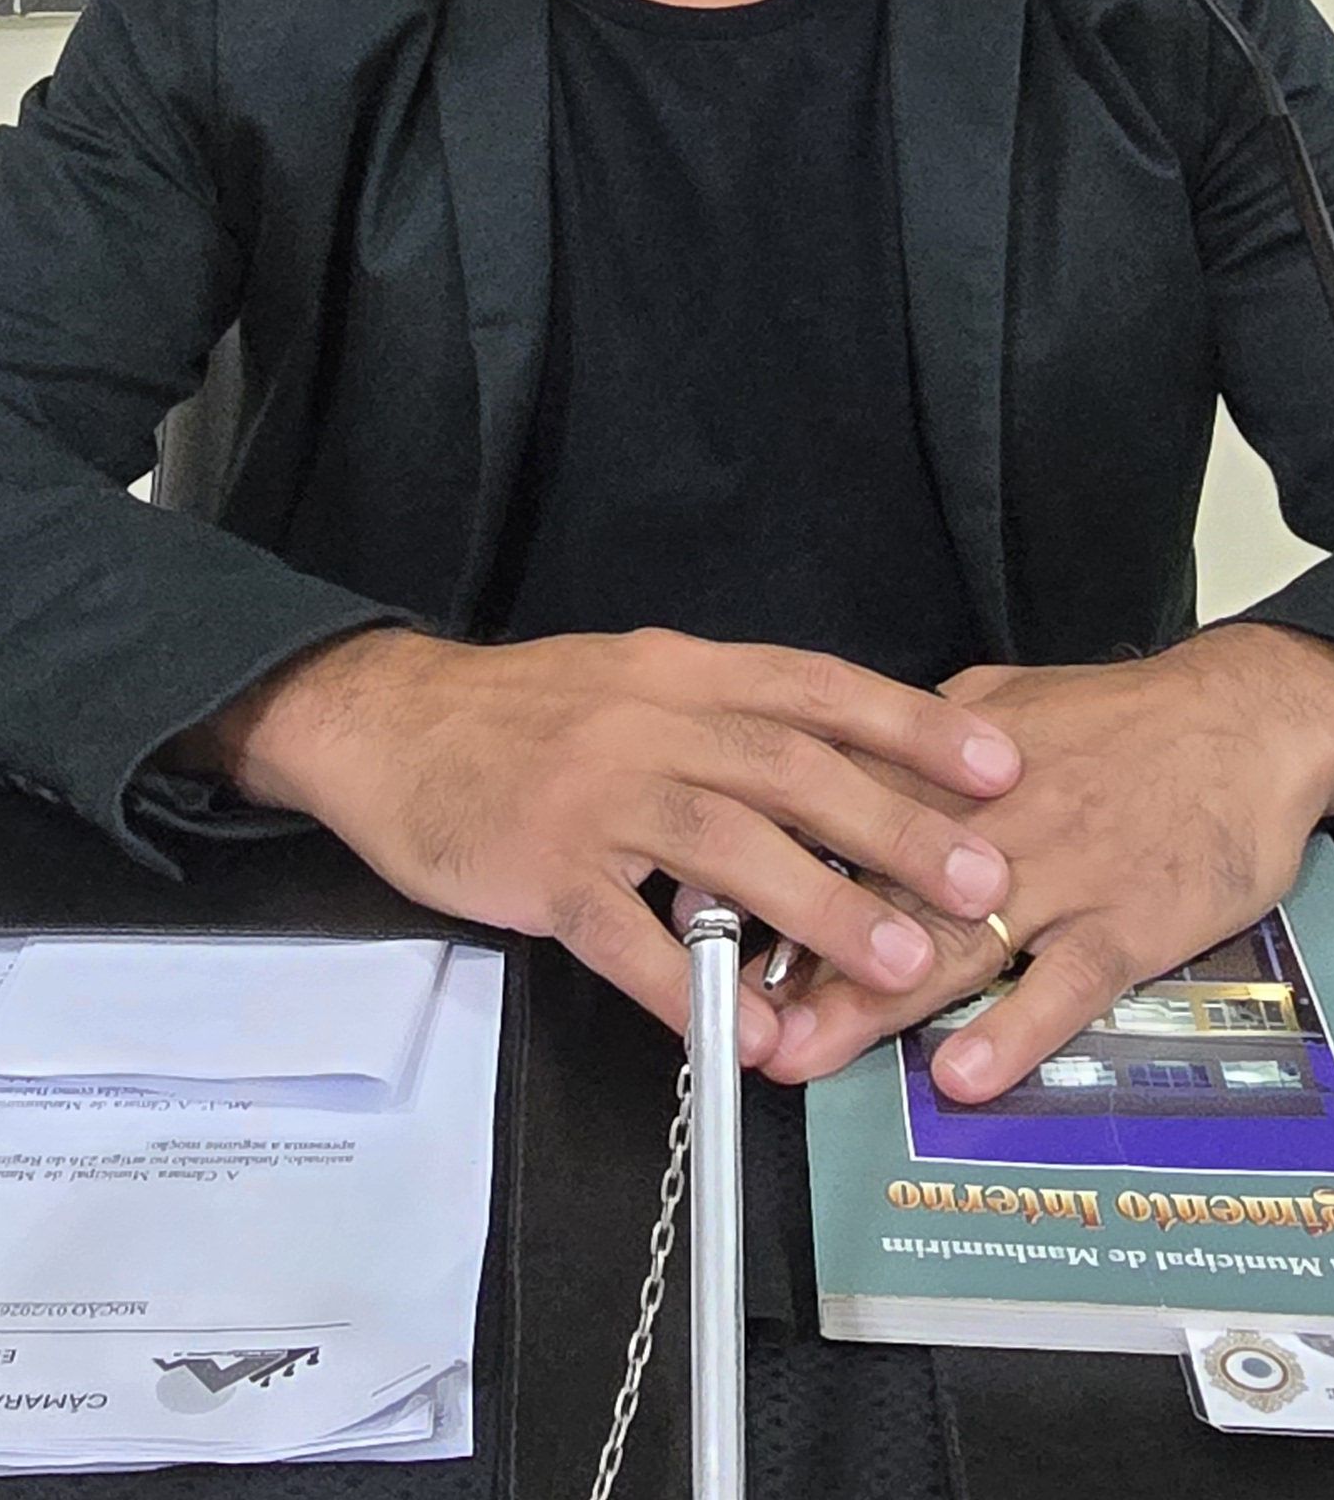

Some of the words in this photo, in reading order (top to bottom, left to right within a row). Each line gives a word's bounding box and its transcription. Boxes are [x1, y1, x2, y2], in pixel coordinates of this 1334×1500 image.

[89, 1100, 108, 1112] de
[205, 1139, 267, 1151] seguinte
[284, 1139, 356, 1151] apresenta
[46, 1156, 66, 1167] do
[101, 1154, 147, 1167] artigo
[172, 1155, 280, 1167] fundamentado
[44, 1170, 63, 1181] de
[69, 1168, 150, 1182] Municipal
[159, 1170, 218, 1181] Câmara
[226, 1170, 239, 1181] A
[884, 1180, 1104, 1231] Interno
[881, 1237, 1101, 1268] Manhumirim
[1107, 1247, 1147, 1270] de
[1156, 1246, 1323, 1278] Municipal
[71, 1301, 149, 1319] MOÇÃO
